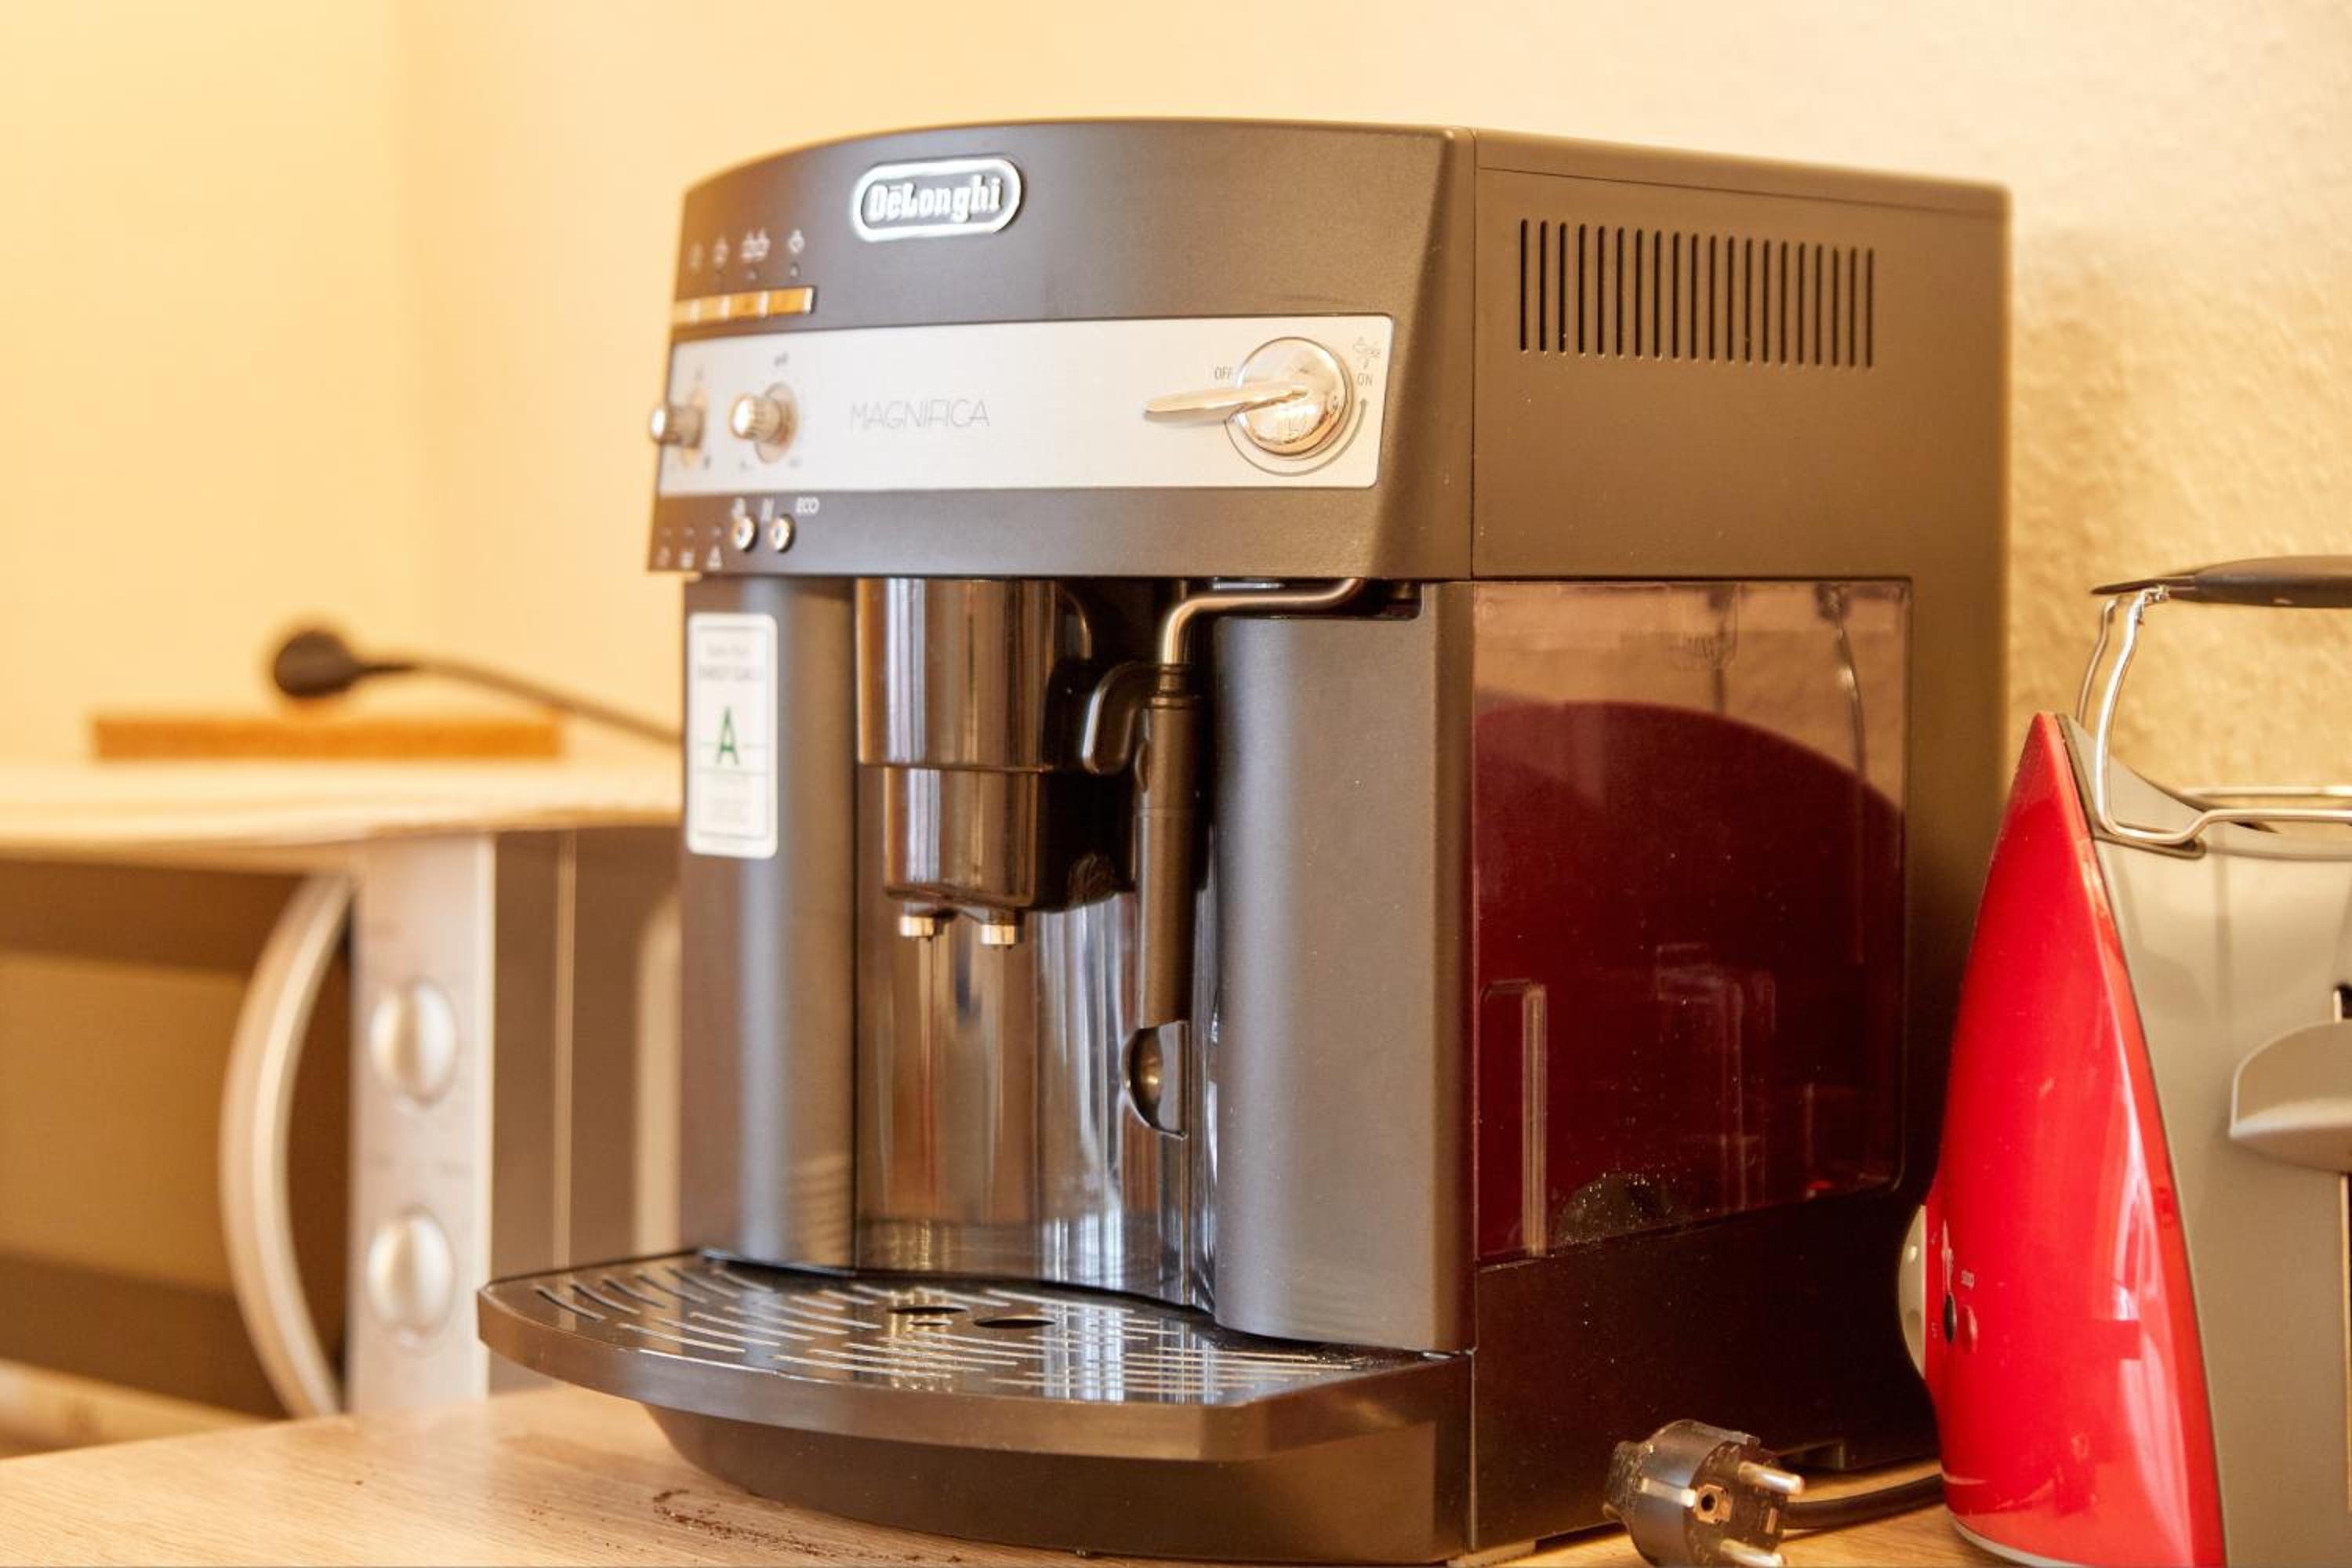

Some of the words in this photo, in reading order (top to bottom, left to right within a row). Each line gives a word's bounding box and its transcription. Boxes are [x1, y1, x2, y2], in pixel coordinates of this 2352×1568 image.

[1215, 366, 1232, 379] OFF
[1357, 373, 1373, 387] ON
[851, 398, 991, 431] MAGNIFICA
[796, 496, 820, 514] ECO
[715, 706, 740, 767] A
